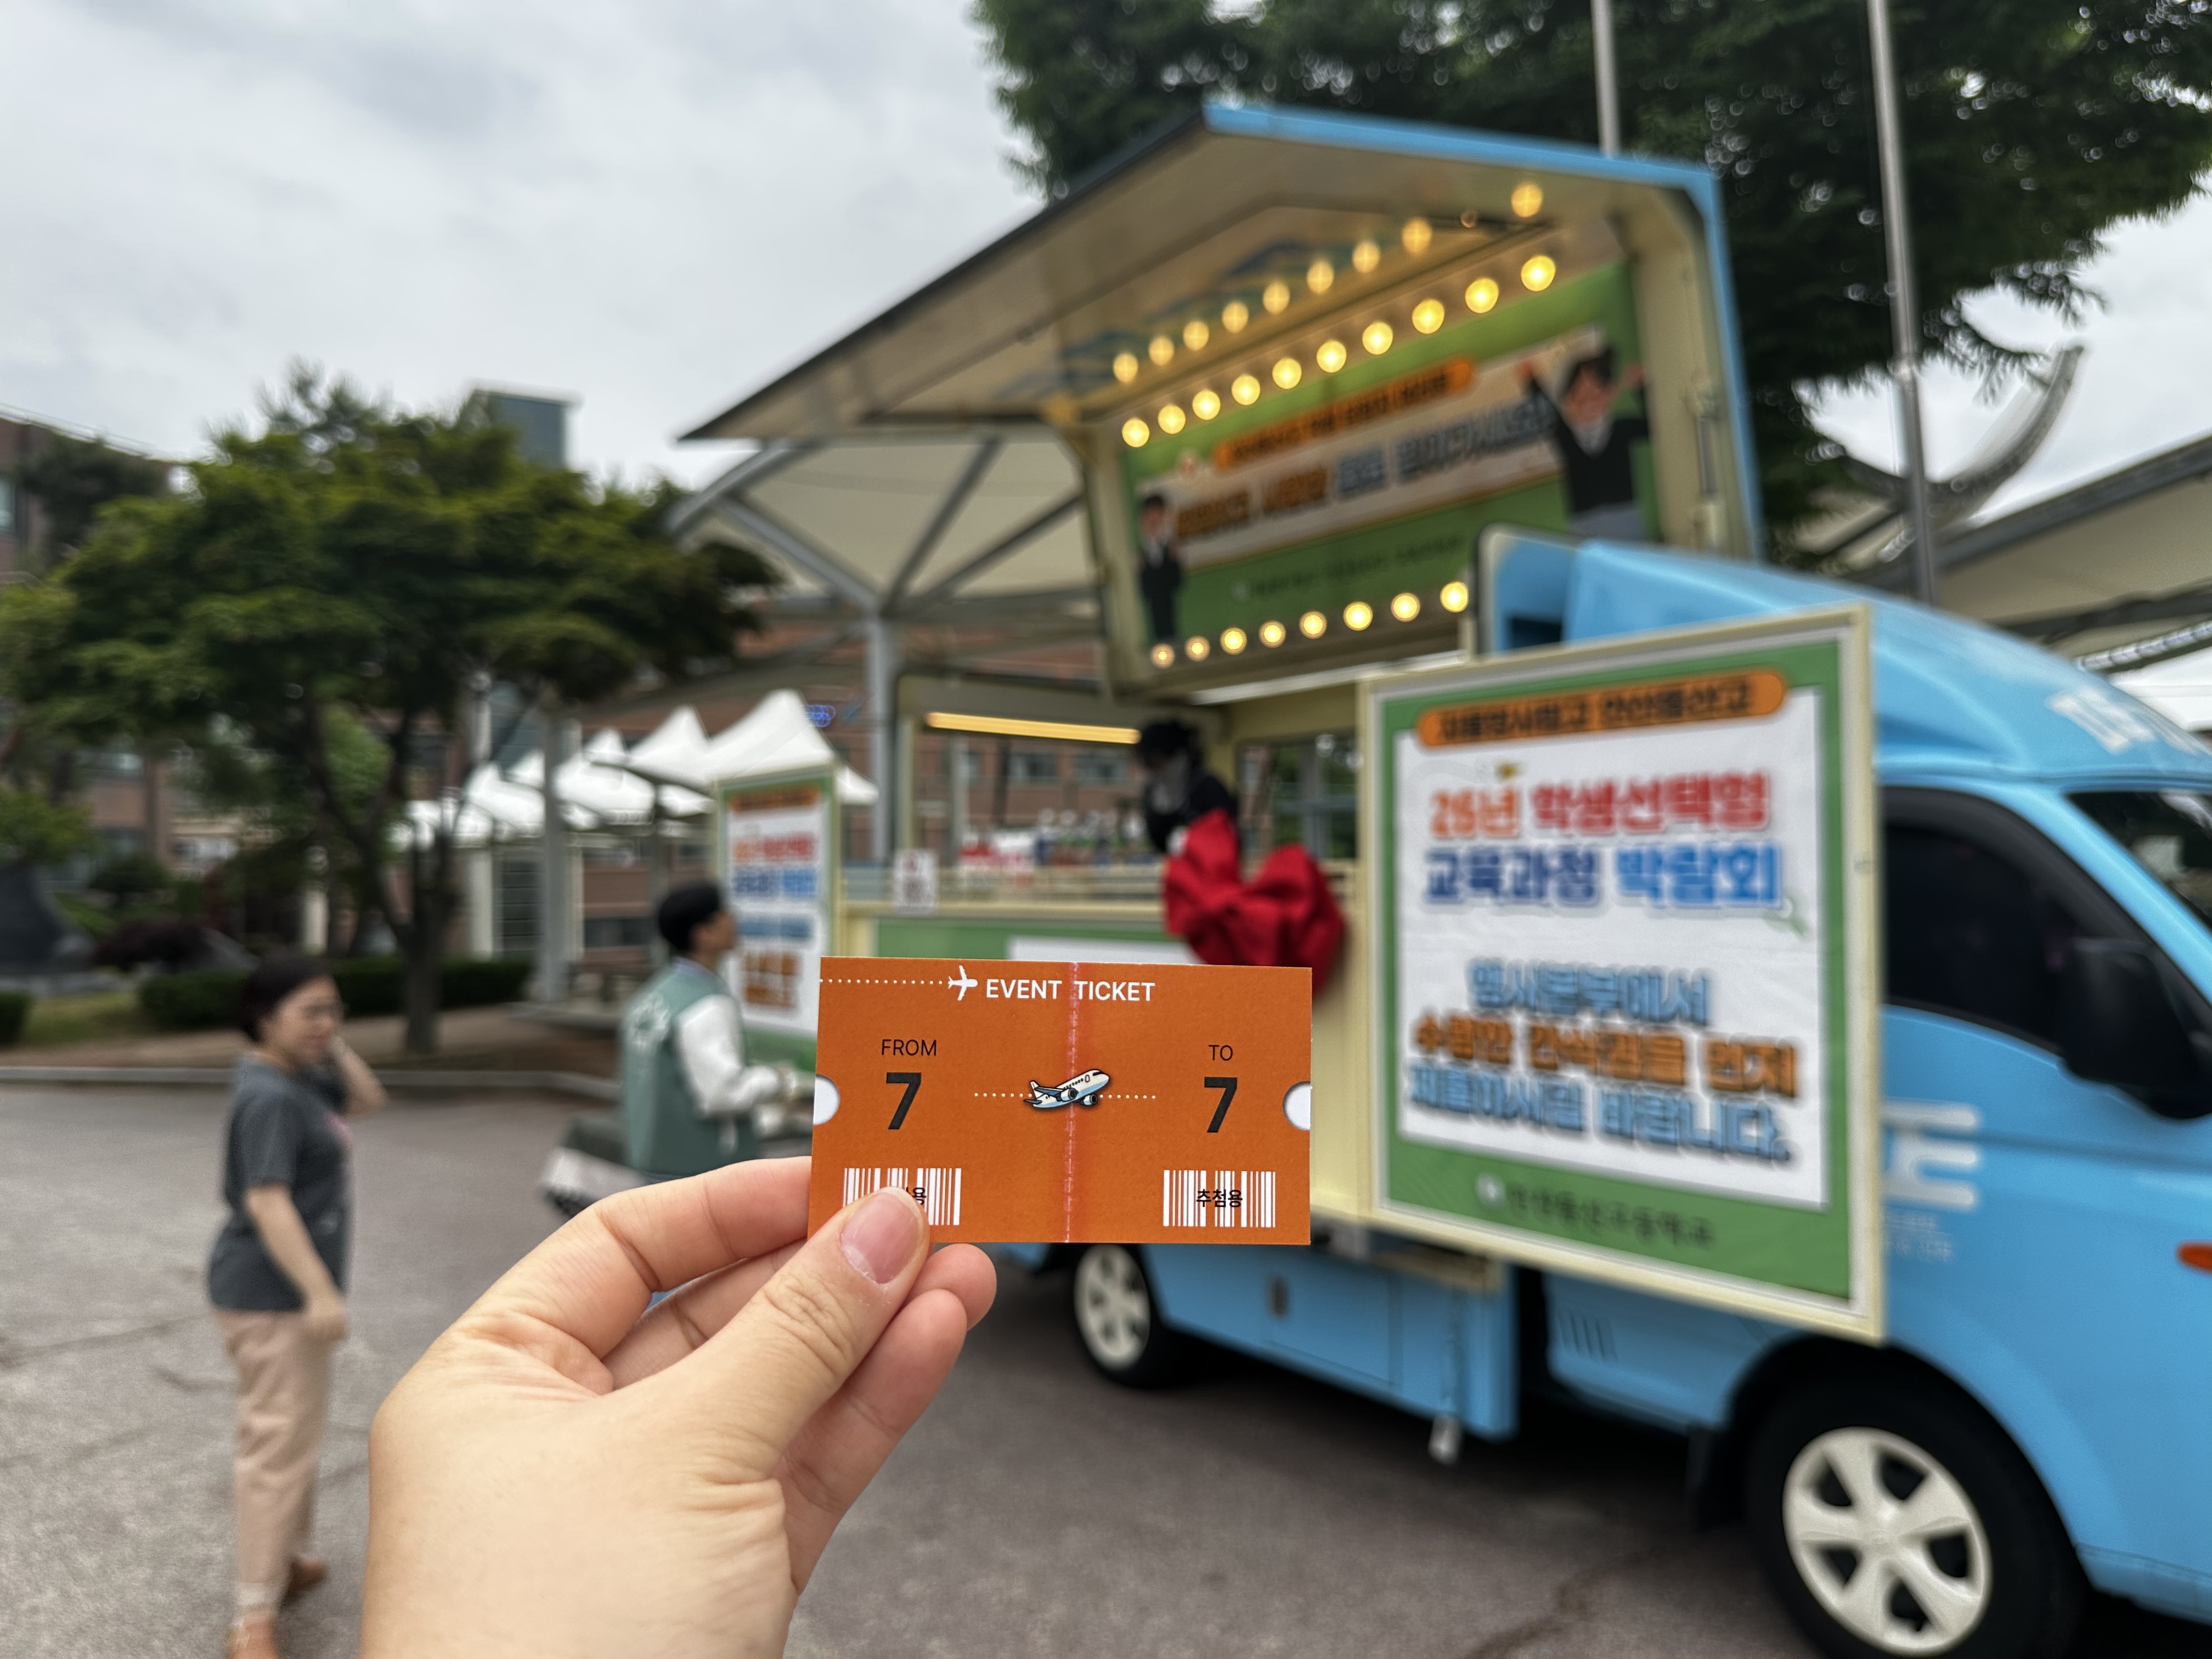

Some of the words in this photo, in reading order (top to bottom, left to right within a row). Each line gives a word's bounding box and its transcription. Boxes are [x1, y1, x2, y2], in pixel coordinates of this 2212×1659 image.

[1426, 847, 1599, 905] 교육과정
[1615, 842, 1782, 909] 박람회
[986, 979, 1063, 1000] EVENT
[1075, 981, 1156, 1002] TICKET
[881, 1039, 938, 1057] FROM
[1208, 1044, 1234, 1062] TO
[885, 1071, 922, 1130] 7
[1204, 1076, 1238, 1134] 7
[1197, 1189, 1243, 1207] 추첨용
